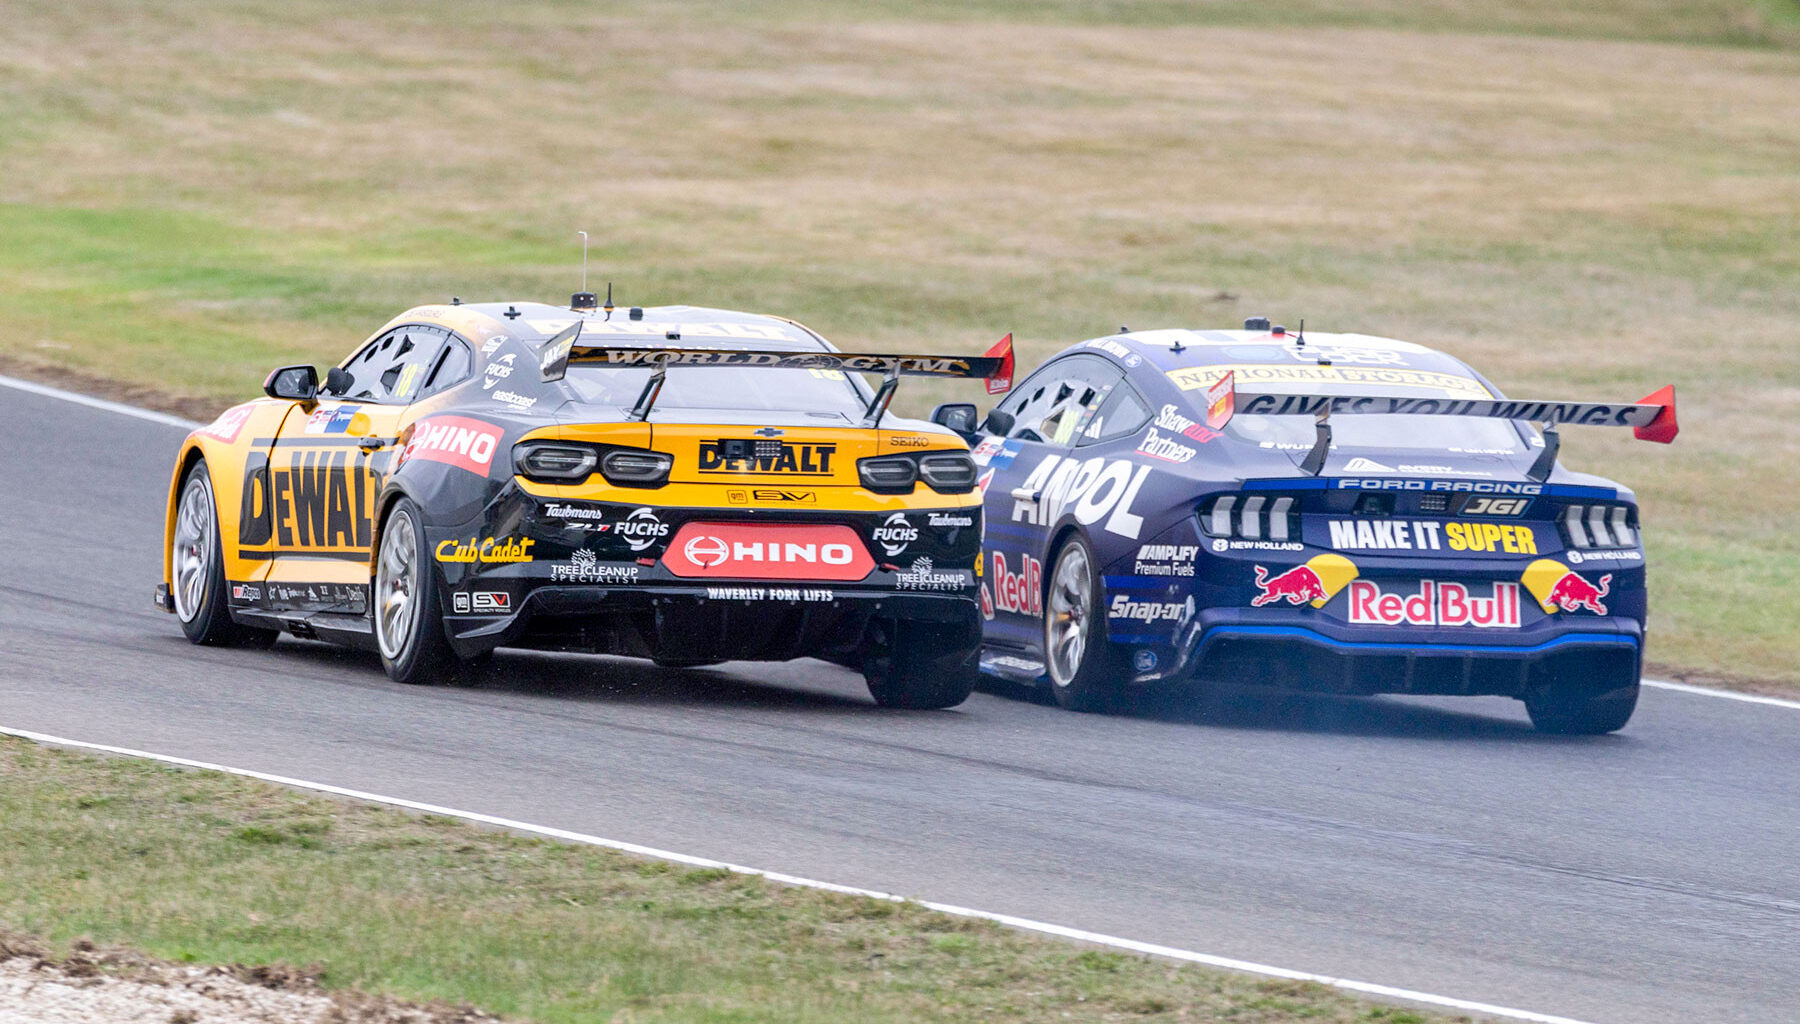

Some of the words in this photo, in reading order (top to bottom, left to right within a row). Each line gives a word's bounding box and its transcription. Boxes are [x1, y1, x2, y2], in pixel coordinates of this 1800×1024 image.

[605, 350, 782, 365] WORLD
[843, 356, 958, 372] GYM
[1178, 364, 1336, 386] NAIONAL
[1154, 404, 1196, 433] Shaw
[422, 425, 496, 464] HINO
[890, 436, 929, 447] SEIKO
[1137, 427, 1197, 463] Partners
[1338, 479, 1425, 490] FORD
[1431, 482, 1542, 495] RACING
[544, 503, 602, 519] Taubmans
[1464, 498, 1528, 515] JGI
[614, 522, 669, 536] FUCHS
[872, 528, 918, 541] FUCHS
[1329, 521, 1408, 549] MAKE
[1412, 522, 1440, 549] IT
[1445, 523, 1538, 554] SUPER
[435, 537, 479, 563] Cub
[479, 537, 535, 563] Cadet
[733, 542, 853, 565] HINO
[1142, 545, 1199, 561] AMPLIFY
[1254, 542, 1304, 551] HOLLAND
[552, 565, 579, 575] TREE
[584, 566, 639, 577] CLEANUP
[1135, 561, 1171, 575] Premium
[1172, 562, 1195, 576] Fuels
[550, 573, 639, 584] SPECIALIST
[896, 573, 918, 584] TREE
[923, 573, 965, 585] CLEANUP
[993, 551, 1031, 614] Red
[707, 588, 765, 601] WAVERLEY
[769, 590, 800, 601] FORK
[803, 590, 834, 602] LIFTS
[896, 583, 966, 591] SPECIALIST
